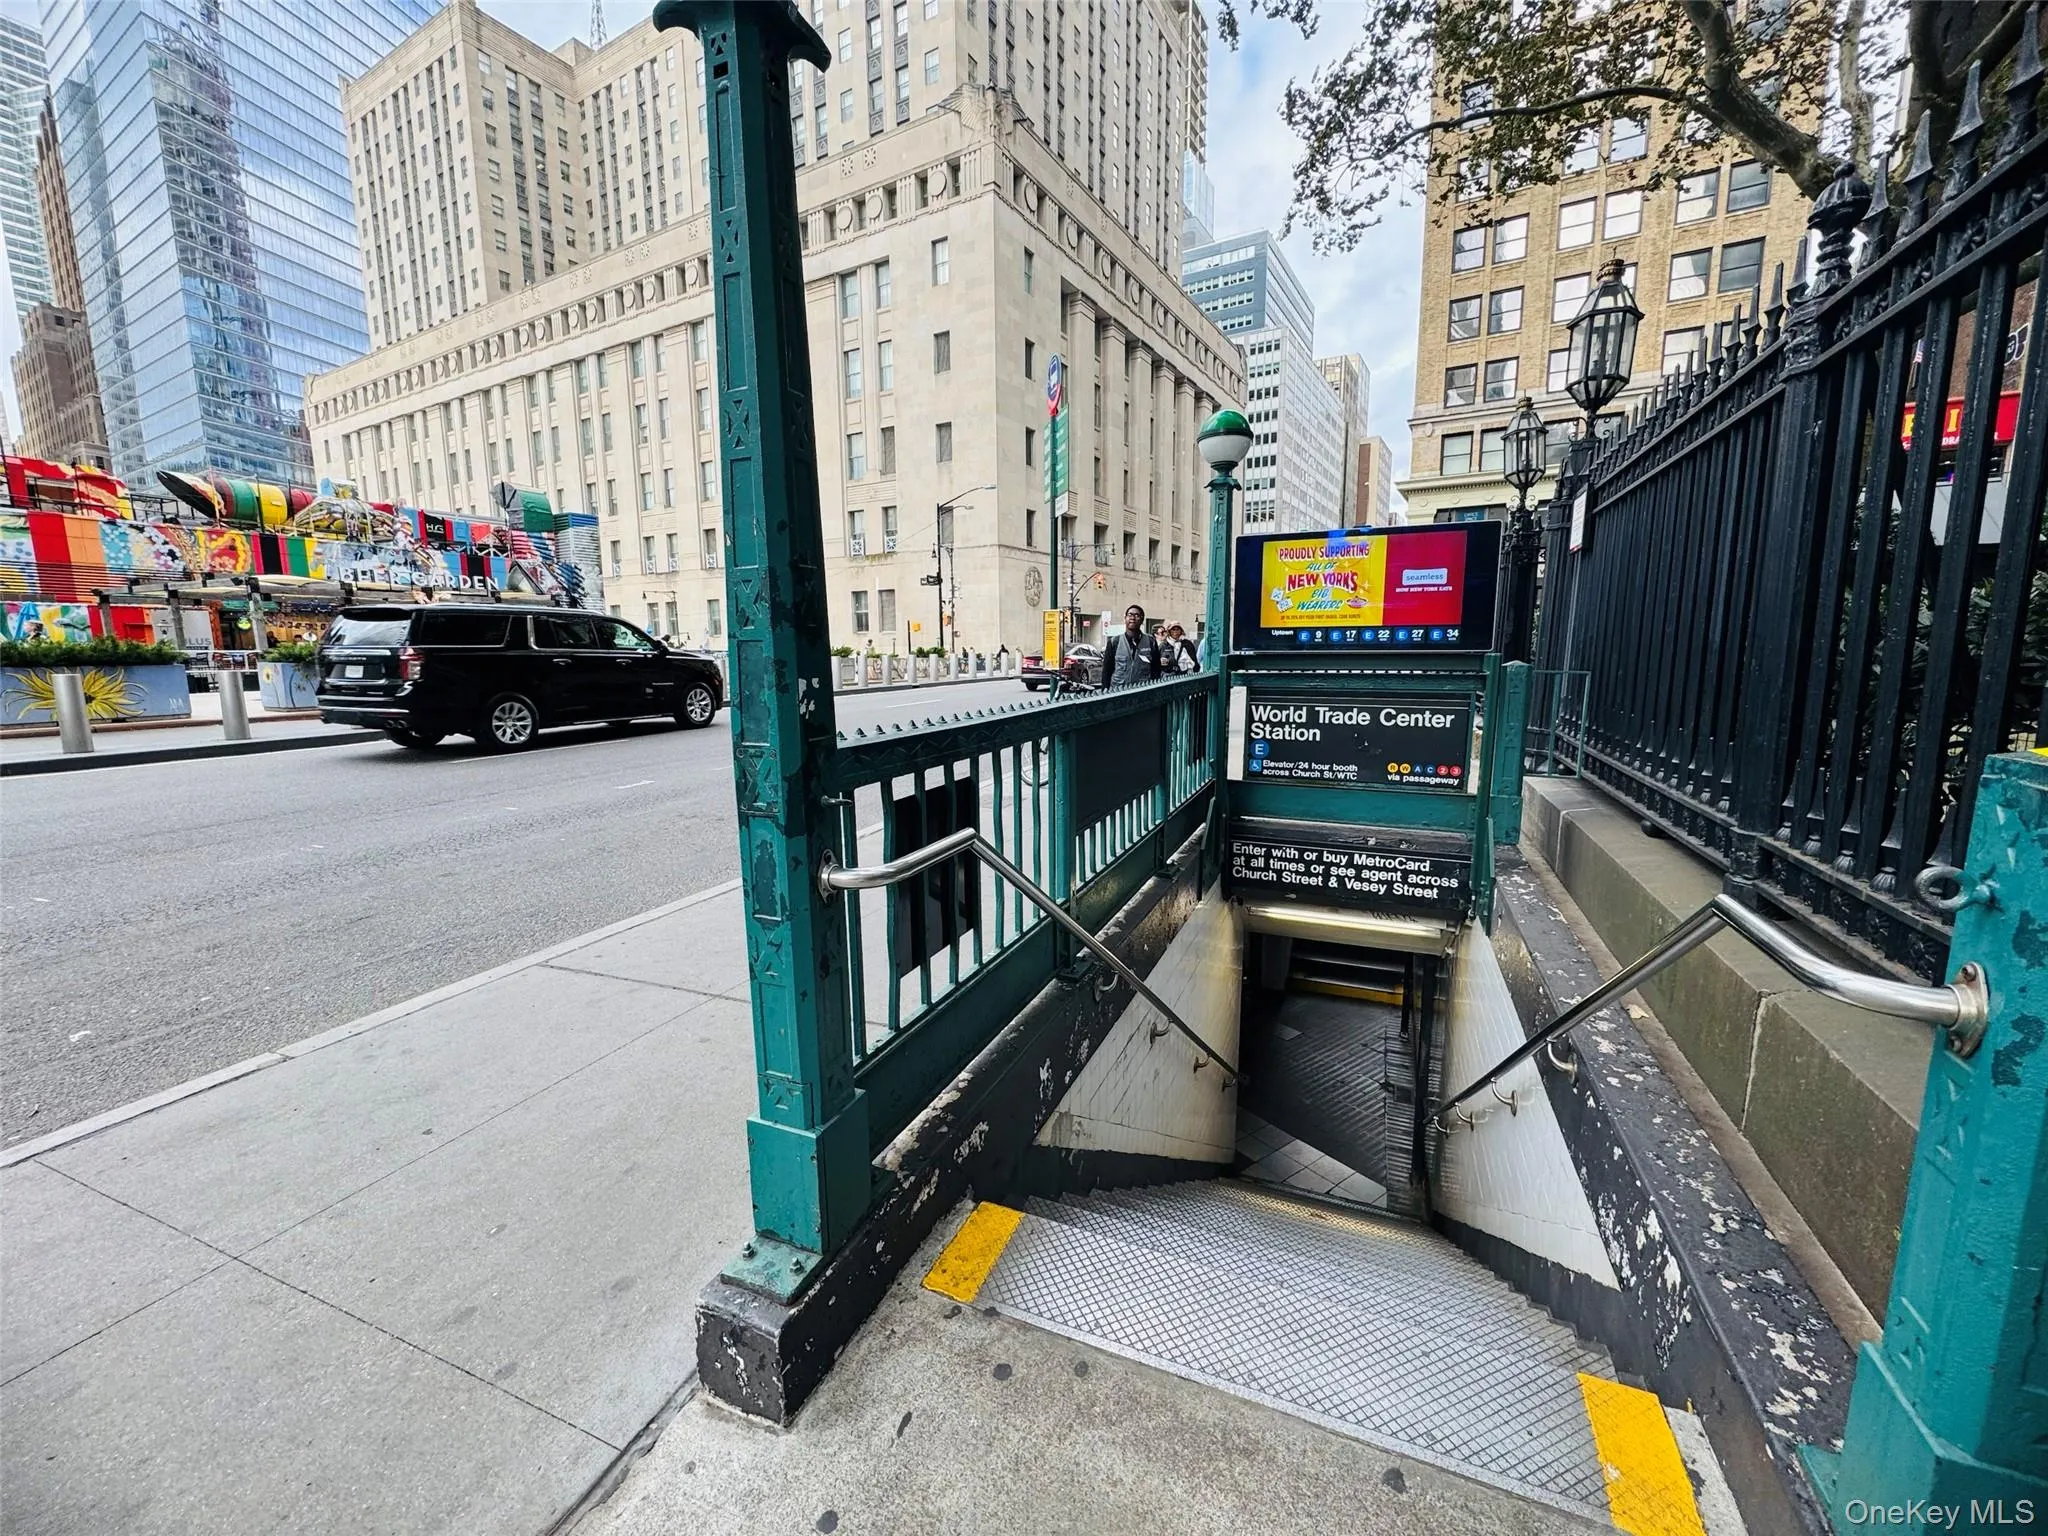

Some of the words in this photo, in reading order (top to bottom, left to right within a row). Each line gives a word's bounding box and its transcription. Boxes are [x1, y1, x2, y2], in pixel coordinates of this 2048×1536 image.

[1280, 546, 1317, 560] PROUDLY
[1319, 543, 1370, 559] SUPPORTING
[340, 567, 402, 586] BEER
[411, 570, 499, 590] GARDEN
[1287, 573, 1319, 592] NEW
[1322, 570, 1358, 593] YORK'S
[1316, 630, 1322, 638] 9
[1378, 630, 1390, 638] 22
[1412, 630, 1424, 638] 27
[1446, 629, 1458, 638] 34
[1251, 705, 1307, 723] World
[1315, 706, 1371, 726] Trade
[1379, 708, 1456, 728] Center
[1250, 722, 1321, 742] Station
[1255, 743, 1265, 755] E
[1262, 759, 1309, 770] Elevator/24
[1311, 762, 1330, 771] hour
[1333, 763, 1358, 773] booth
[1262, 768, 1290, 776] across
[1292, 769, 1321, 778] Church
[1323, 770, 1358, 781] St/WTC
[1387, 773, 1400, 781] via
[1402, 774, 1460, 786] passageway
[1233, 842, 1267, 856] Enter
[1271, 847, 1299, 859] with
[1303, 851, 1318, 860] or
[1322, 851, 1348, 866] buy
[1353, 854, 1431, 872] MetroCard
[1232, 855, 1246, 866] at
[1250, 857, 1265, 868] all
[1269, 858, 1306, 873] times
[1310, 864, 1325, 874] or
[1329, 866, 1356, 877] see
[1361, 869, 1402, 882] agent
[1407, 873, 1459, 888] across
[1232, 866, 1277, 882] Church
[1281, 871, 1324, 887] Street
[1328, 876, 1339, 888] &
[1344, 877, 1388, 895] Vesey
[1392, 882, 1439, 899] Street
